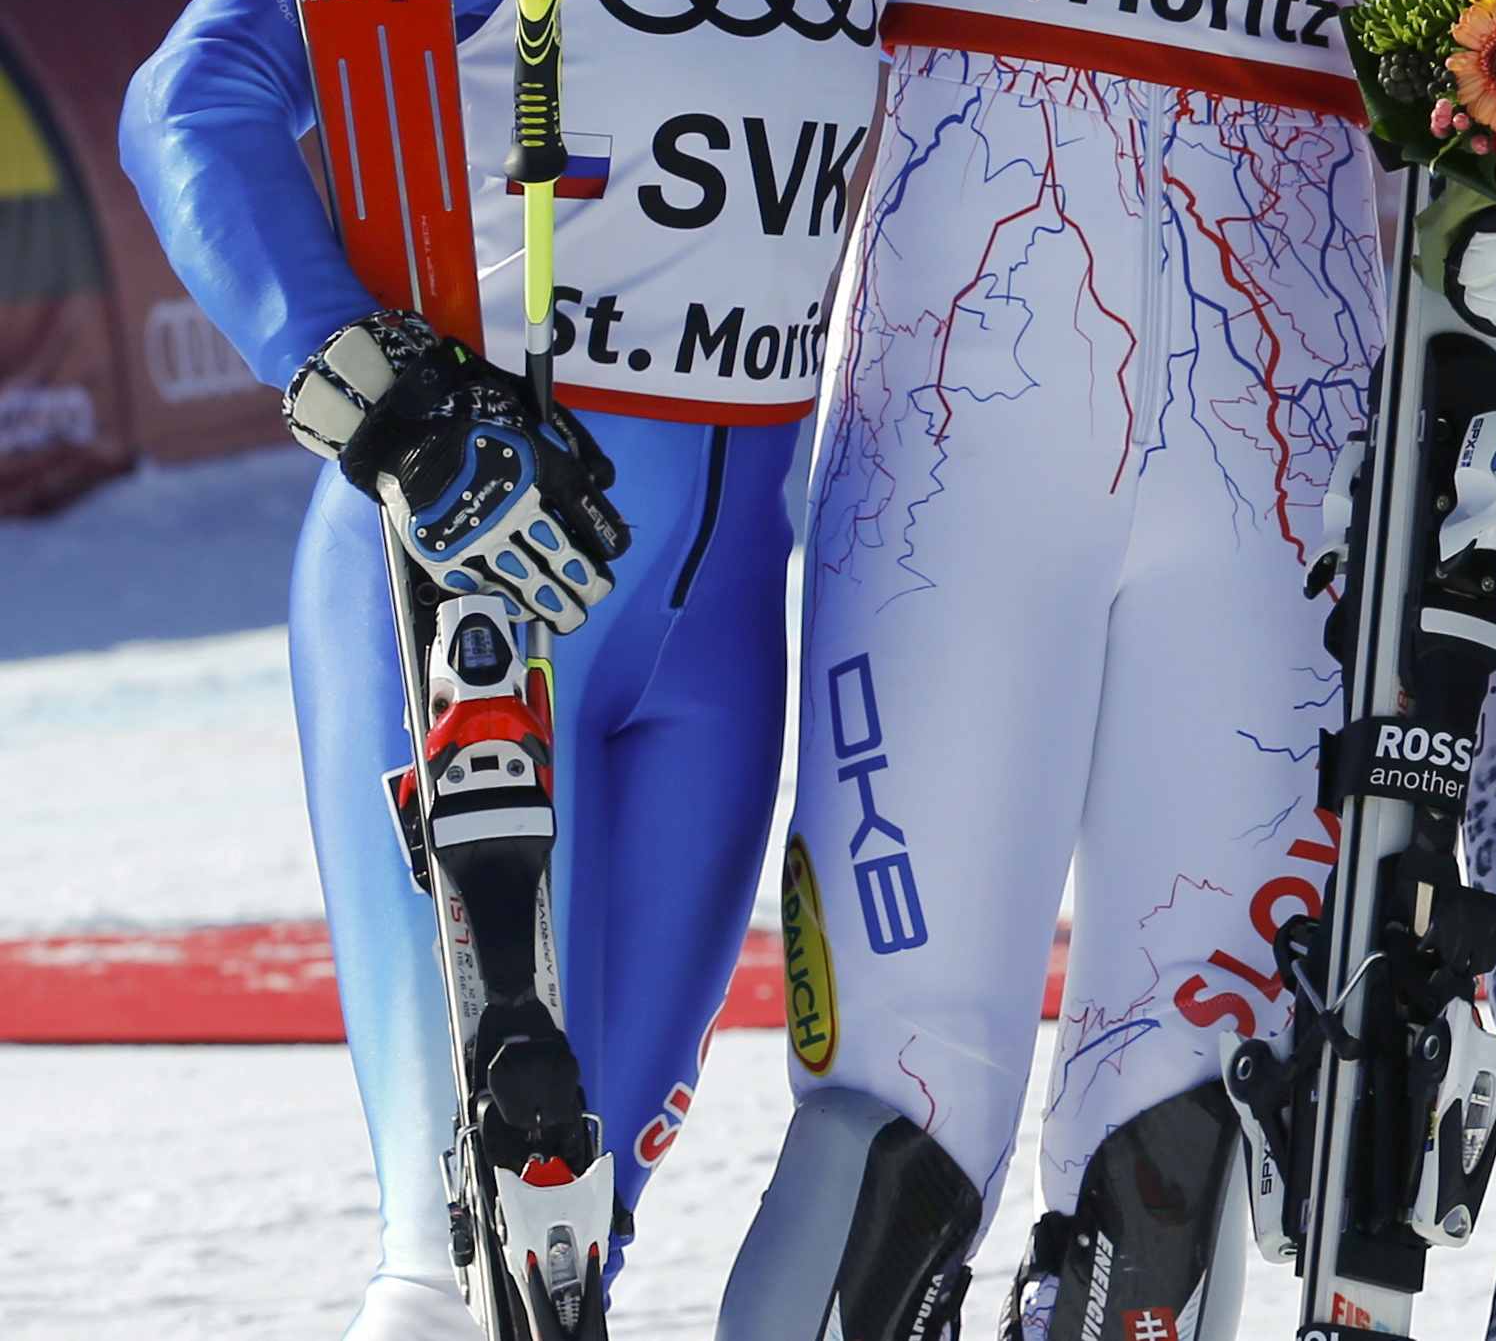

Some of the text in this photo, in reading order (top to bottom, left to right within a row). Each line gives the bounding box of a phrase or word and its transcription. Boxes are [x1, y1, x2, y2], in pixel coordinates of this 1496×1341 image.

[637, 112, 868, 238] SVK
[674, 296, 825, 383] Morit
[1369, 766, 1466, 800] another
[1374, 723, 1475, 773] ROSS
[782, 889, 827, 1051] RAUCH
